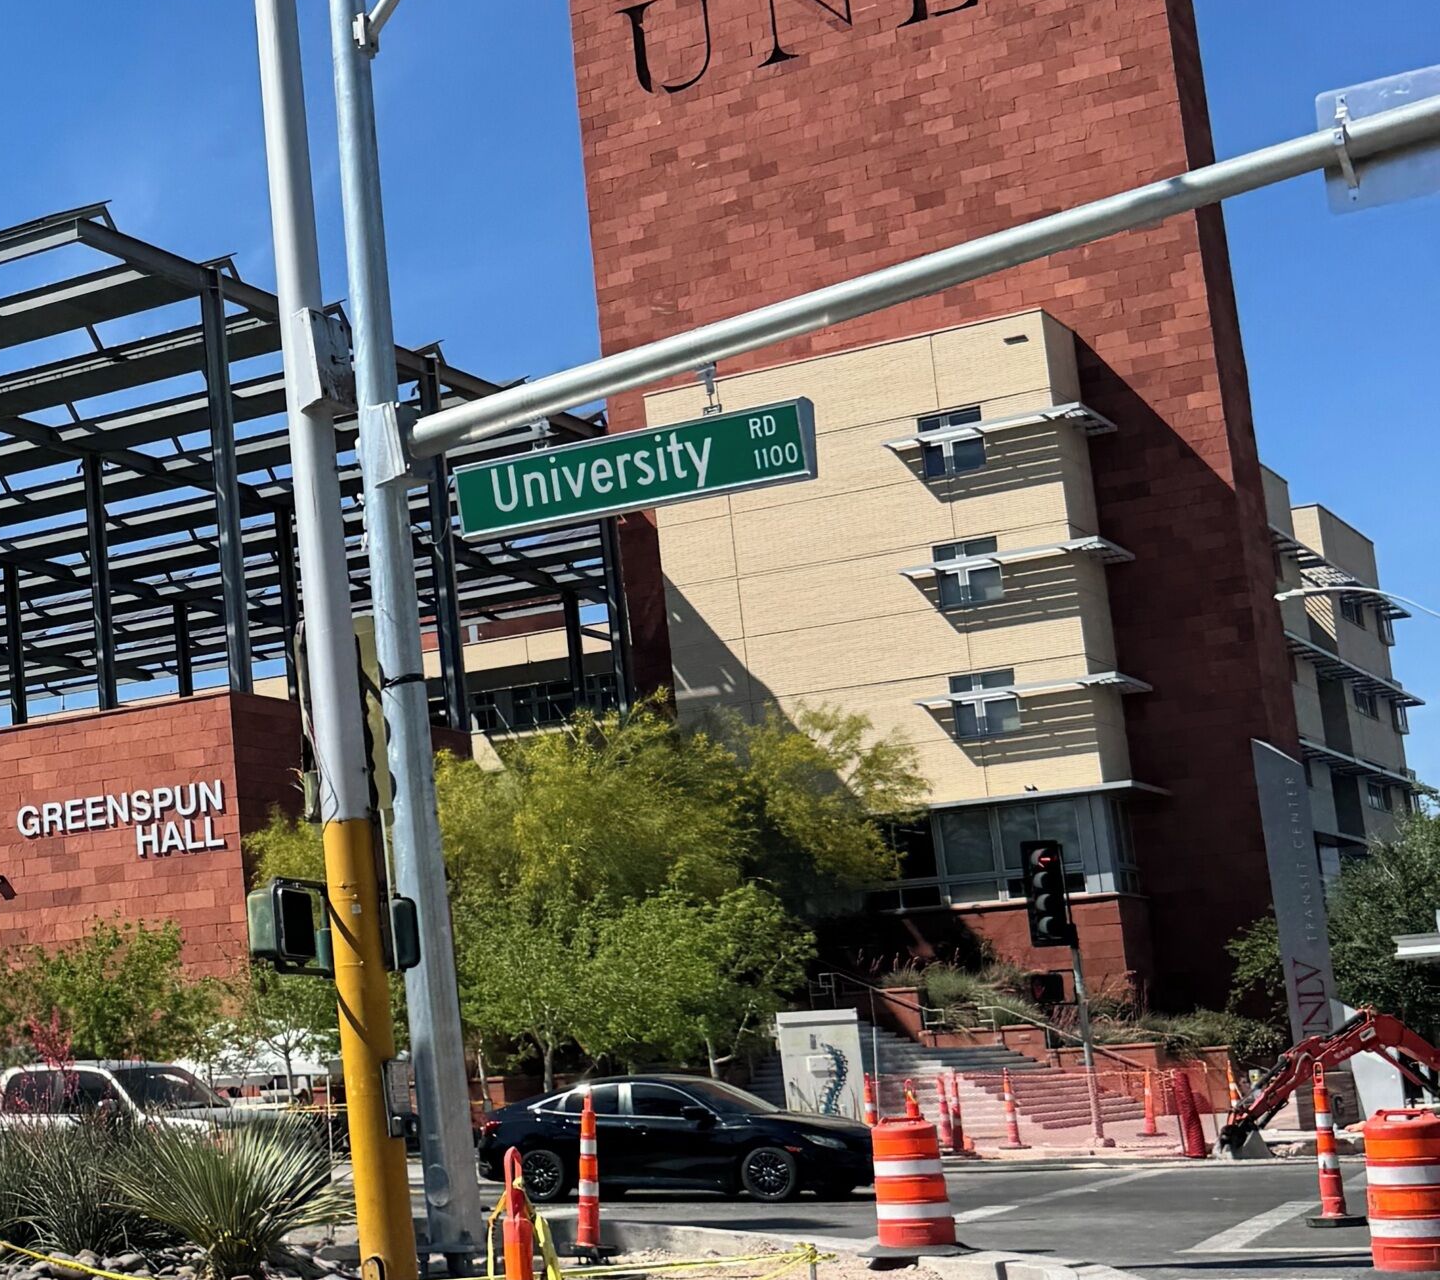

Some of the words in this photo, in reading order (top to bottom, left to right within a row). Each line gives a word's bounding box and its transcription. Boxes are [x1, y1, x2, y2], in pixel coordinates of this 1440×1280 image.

[490, 431, 713, 513] University
[748, 414, 777, 439] RD
[753, 441, 799, 470] 1100
[16, 779, 224, 838] GREENSPUN
[135, 815, 225, 856] HALL
[1284, 777, 1305, 850] CENTER
[1296, 863, 1318, 941] TRANSIT
